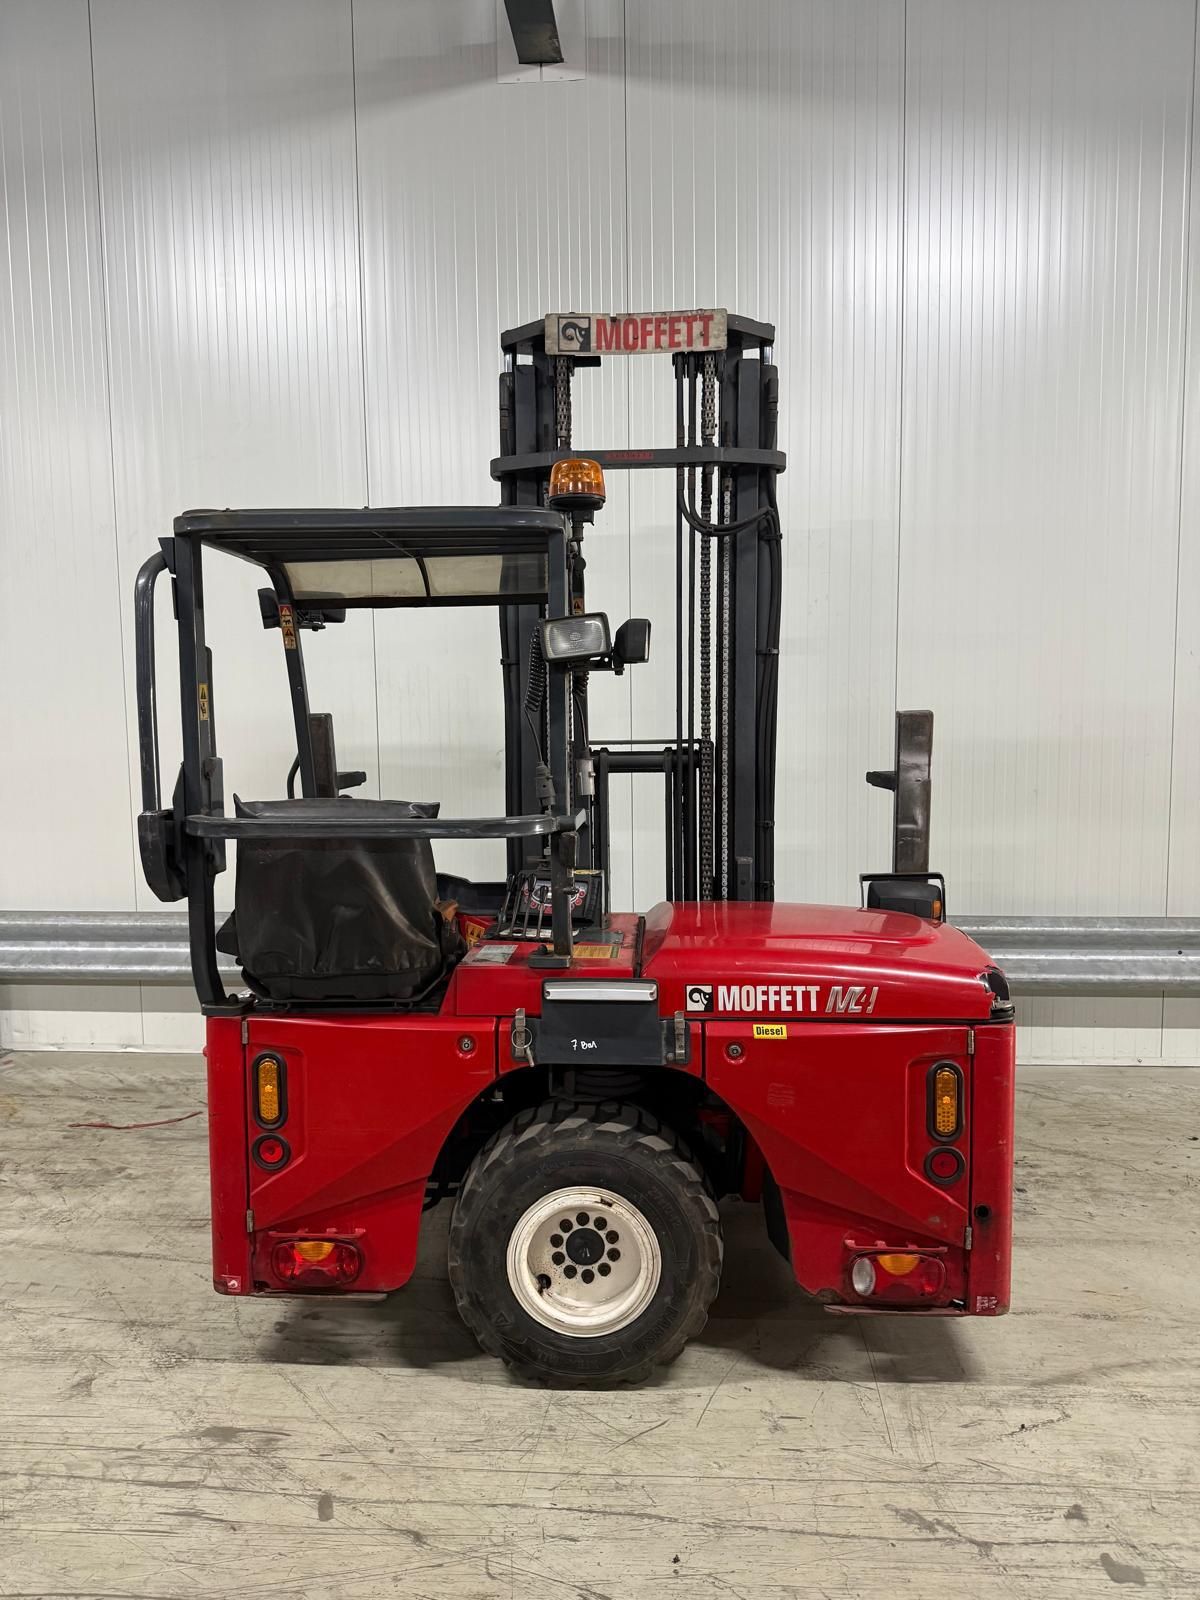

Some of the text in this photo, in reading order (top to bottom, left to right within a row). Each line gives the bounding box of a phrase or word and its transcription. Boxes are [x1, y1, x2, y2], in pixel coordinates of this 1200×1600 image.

[596, 314, 714, 351] MOFFETT
[717, 985, 820, 1012] MOFFETT
[756, 1026, 784, 1036] Diesel
[570, 1039, 577, 1051] 7
